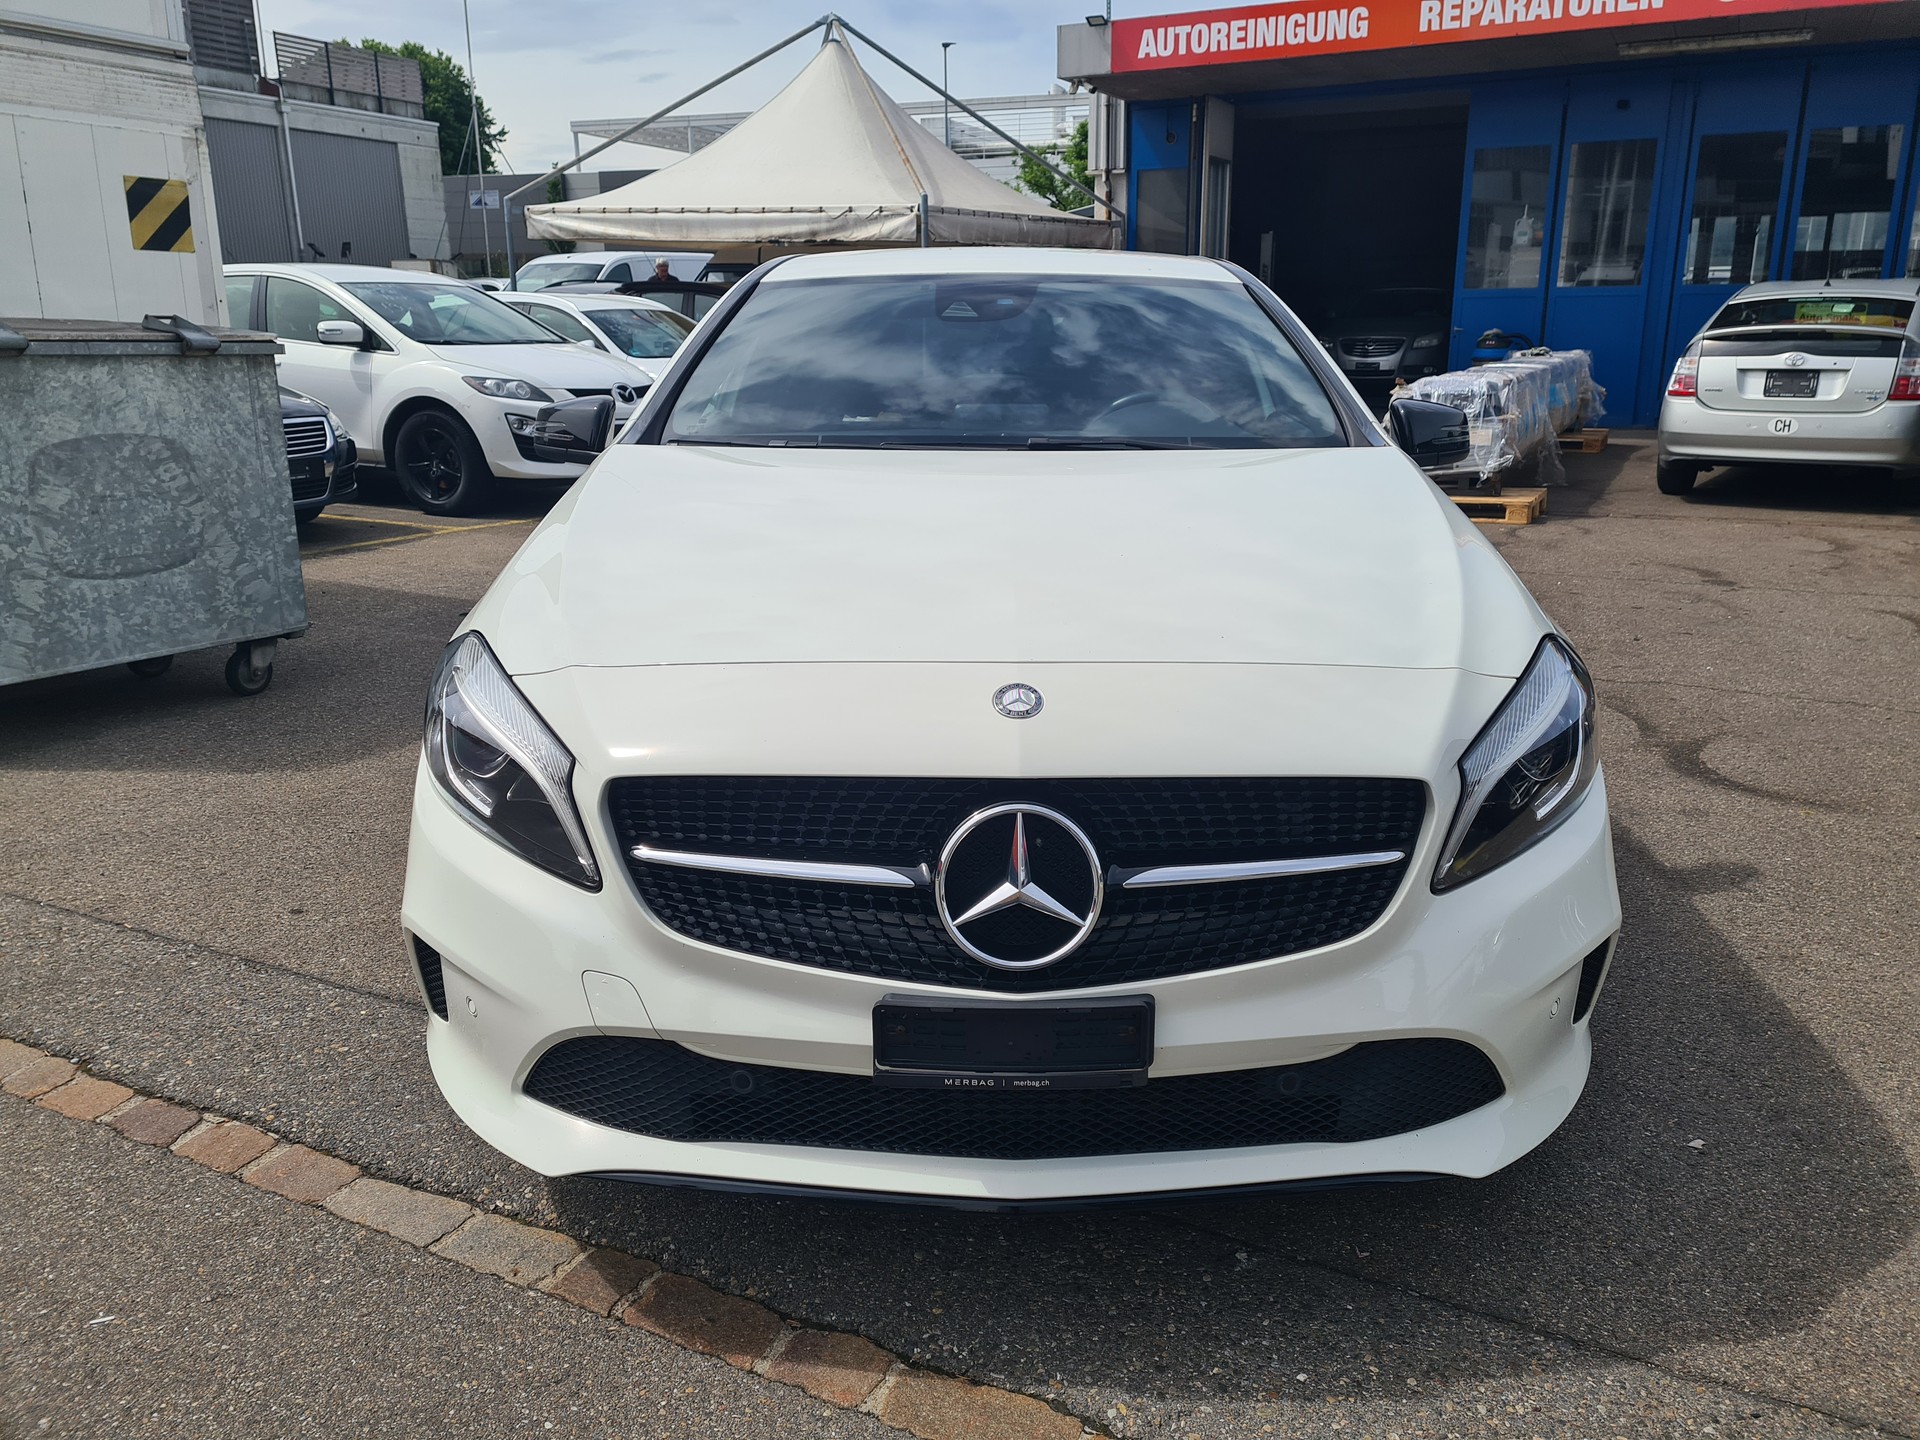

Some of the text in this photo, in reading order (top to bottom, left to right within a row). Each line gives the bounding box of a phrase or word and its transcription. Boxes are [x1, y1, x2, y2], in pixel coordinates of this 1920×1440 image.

[1137, 0, 1665, 59] AUTOREINIGUNG REPARATU
[1774, 419, 1792, 433] CH
[944, 1078, 1050, 1087] MERBAG merbag.ch
